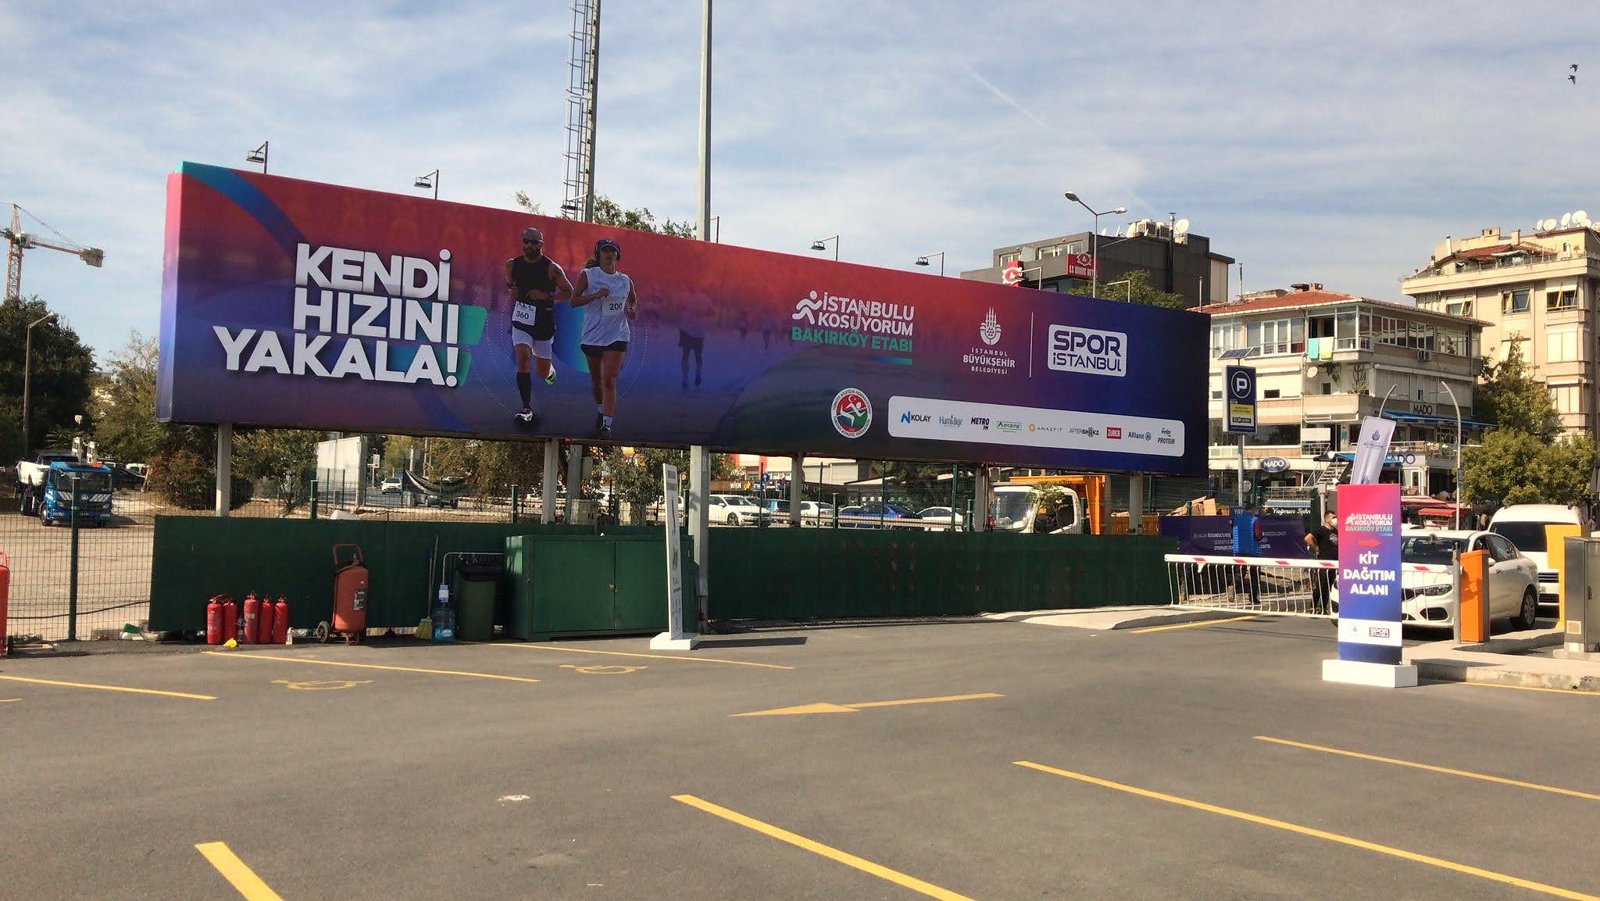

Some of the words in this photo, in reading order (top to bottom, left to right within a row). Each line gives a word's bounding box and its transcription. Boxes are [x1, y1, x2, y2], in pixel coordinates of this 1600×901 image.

[295, 243, 451, 301] KENDİ
[823, 292, 914, 320] İSTANBULU
[293, 287, 459, 344] HIZINI
[516, 310, 529, 320] 360
[792, 326, 868, 348] BAKIRKÖY
[871, 335, 912, 352] ETABI
[1053, 329, 1121, 357] SPOR
[212, 325, 459, 387] YAKALA!
[971, 346, 1008, 357] İSTANBUL
[971, 366, 1008, 375] BELEDİYESİ
[1413, 404, 1433, 415] MADO
[971, 417, 990, 425] METRO
[1263, 460, 1285, 468] MADO
[1359, 551, 1379, 565] KİT
[1343, 567, 1396, 582] DAĞITIM
[1350, 583, 1389, 596] ALANI
